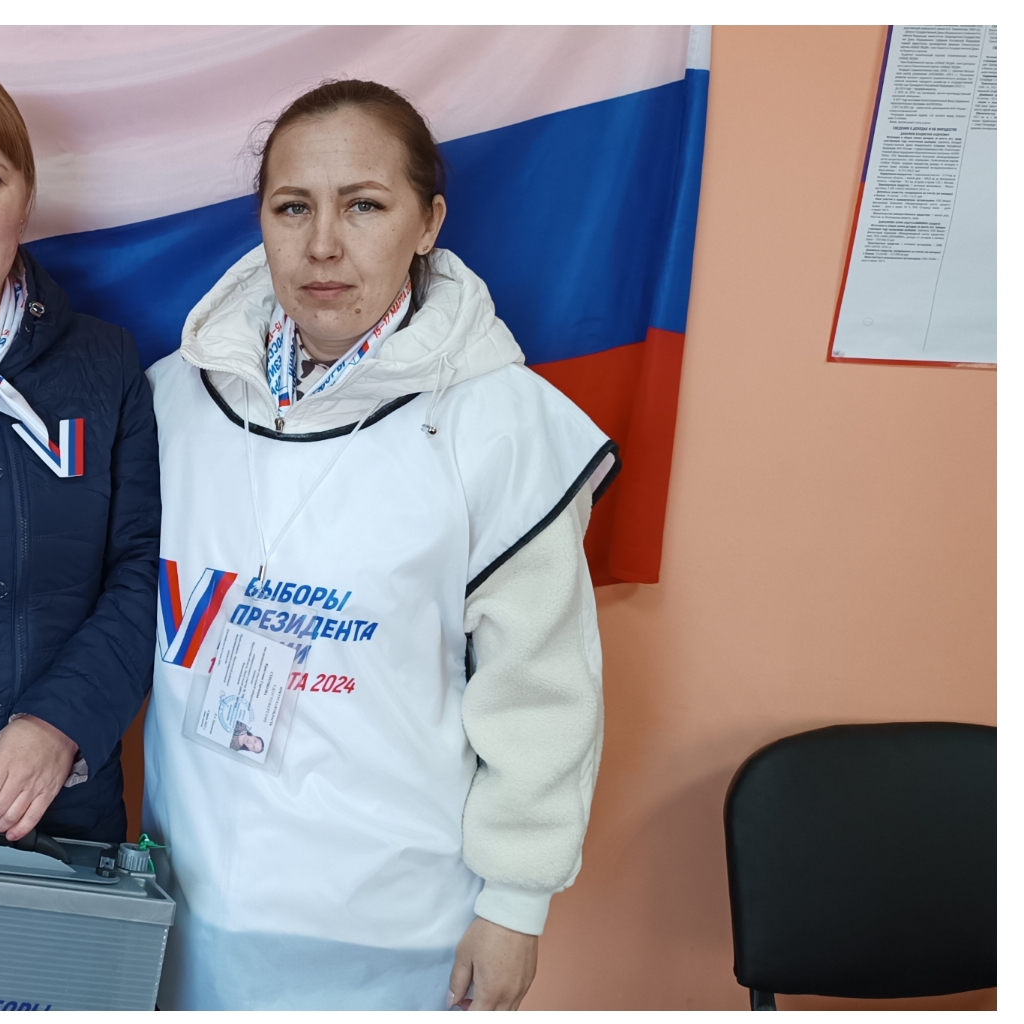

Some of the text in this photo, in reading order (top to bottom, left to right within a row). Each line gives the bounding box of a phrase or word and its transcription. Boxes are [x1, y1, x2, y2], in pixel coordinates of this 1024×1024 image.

[244, 576, 353, 612] ВЫБОРЫ
[230, 603, 378, 642] ПРЕЗИДЕНТА
[310, 674, 355, 694] 2024
